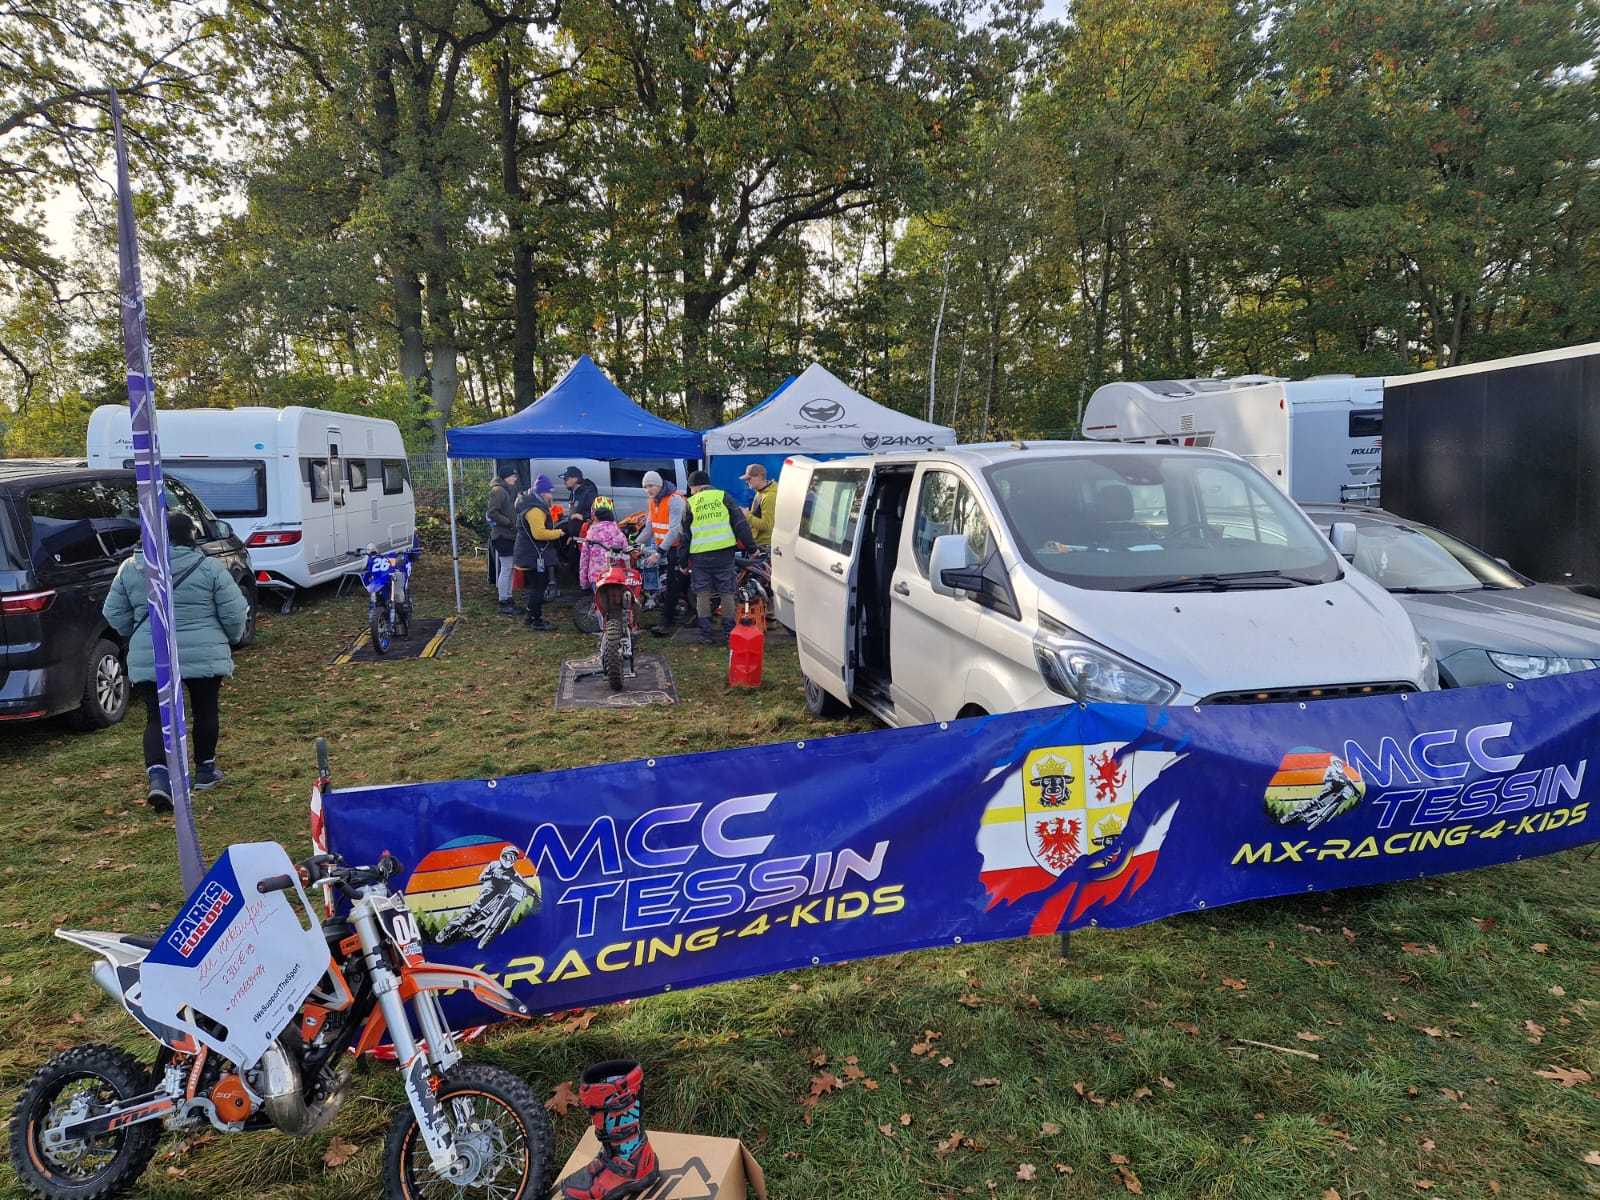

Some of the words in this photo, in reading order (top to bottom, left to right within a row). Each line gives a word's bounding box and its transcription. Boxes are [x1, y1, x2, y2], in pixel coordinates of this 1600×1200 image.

[746, 437, 802, 447] 24MX
[881, 436, 935, 446] 24MX
[1351, 447, 1381, 455] ROLLER
[372, 557, 390, 572] 26
[1343, 721, 1525, 787] MCC
[1372, 759, 1588, 829] TESSIN
[523, 791, 779, 883] MCC
[1231, 802, 1591, 866] MX-RACING-4-KIDS
[167, 880, 226, 952] PARTS
[557, 840, 890, 939] TESSIN
[180, 890, 235, 959] EUROPE
[252, 962, 301, 1023] #WeSupportTheSport
